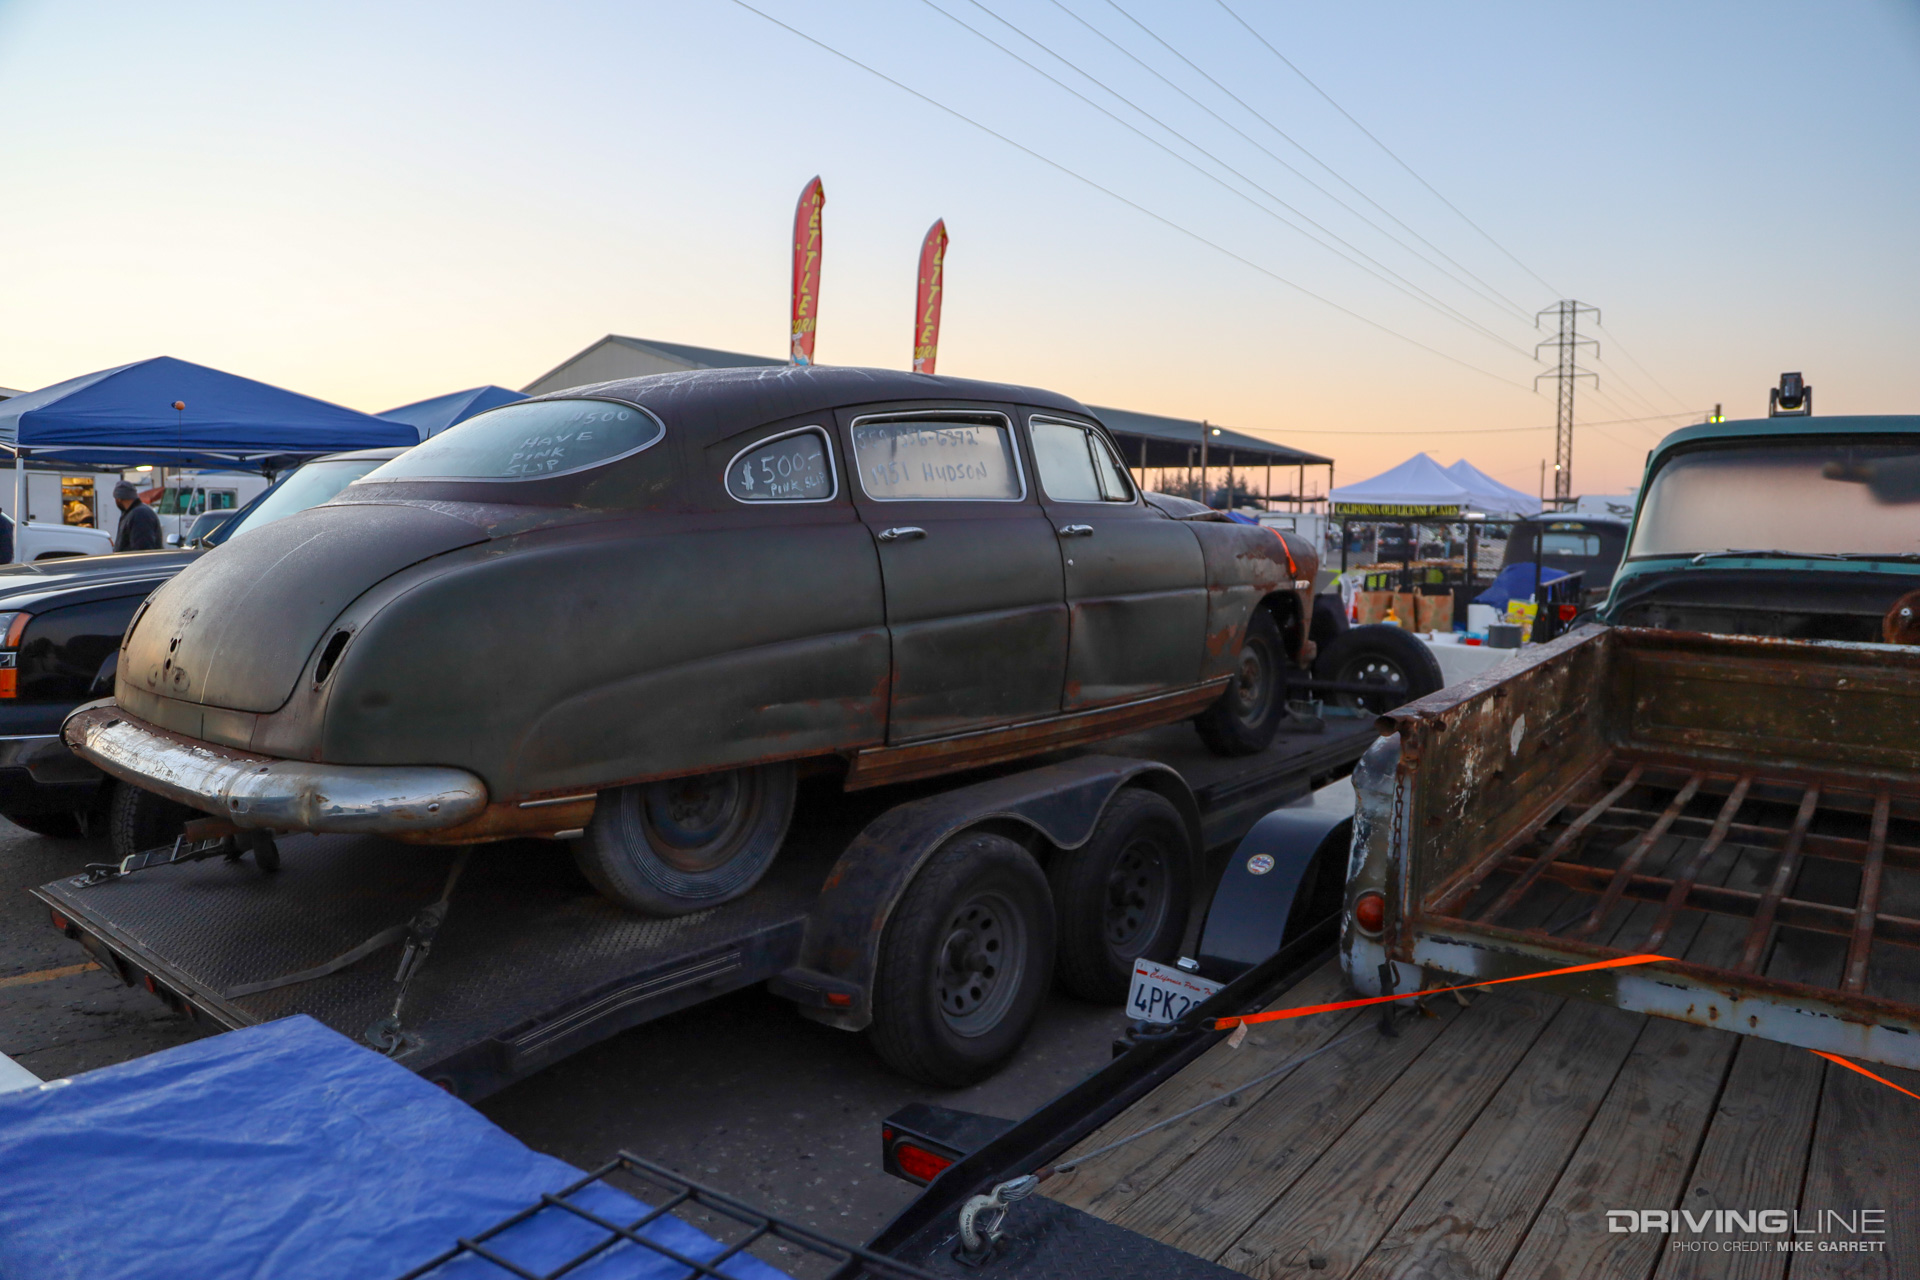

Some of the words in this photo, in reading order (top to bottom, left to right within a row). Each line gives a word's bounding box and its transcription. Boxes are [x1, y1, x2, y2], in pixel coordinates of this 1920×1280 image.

[520, 431, 593, 449] HAVE
[508, 447, 565, 465] PINK
[502, 459, 559, 475] SLIP
[871, 461, 910, 486] 1951
[922, 461, 988, 483] HUDSON
[771, 480, 804, 497] PINK
[804, 472, 825, 489] SLIP
[1429, 504, 1458, 516] PLATES
[1150, 971, 1182, 985] California
[1184, 981, 1200, 991] Perm
